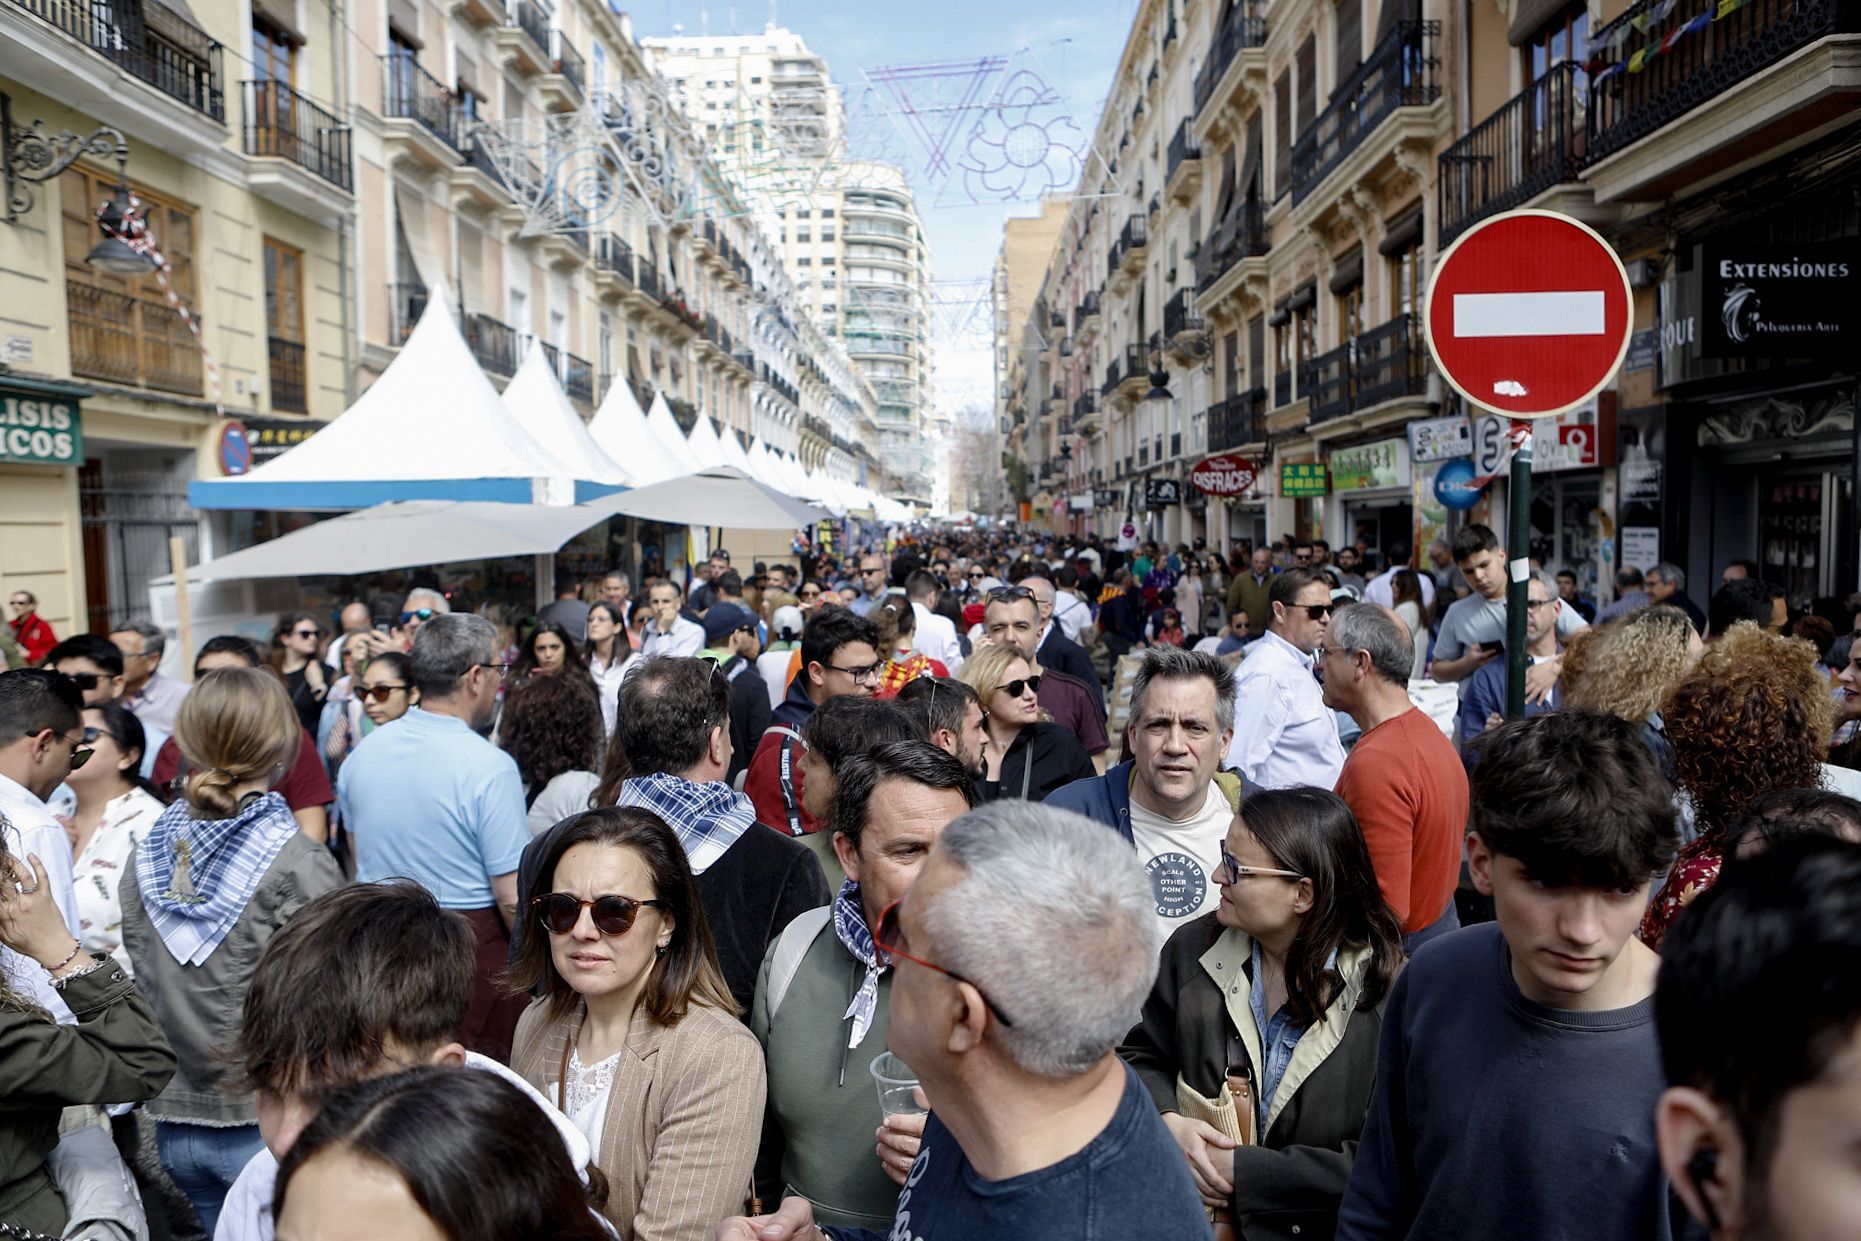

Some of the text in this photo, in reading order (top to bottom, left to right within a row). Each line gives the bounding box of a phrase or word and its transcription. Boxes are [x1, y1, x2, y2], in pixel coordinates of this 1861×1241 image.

[1192, 469, 1253, 493] DISFRACES
[1145, 854, 1201, 876] NEWLAND
[1161, 868, 1185, 876] SCALE
[1160, 878, 1187, 886] OTHER
[1163, 895, 1184, 903] HIGH
